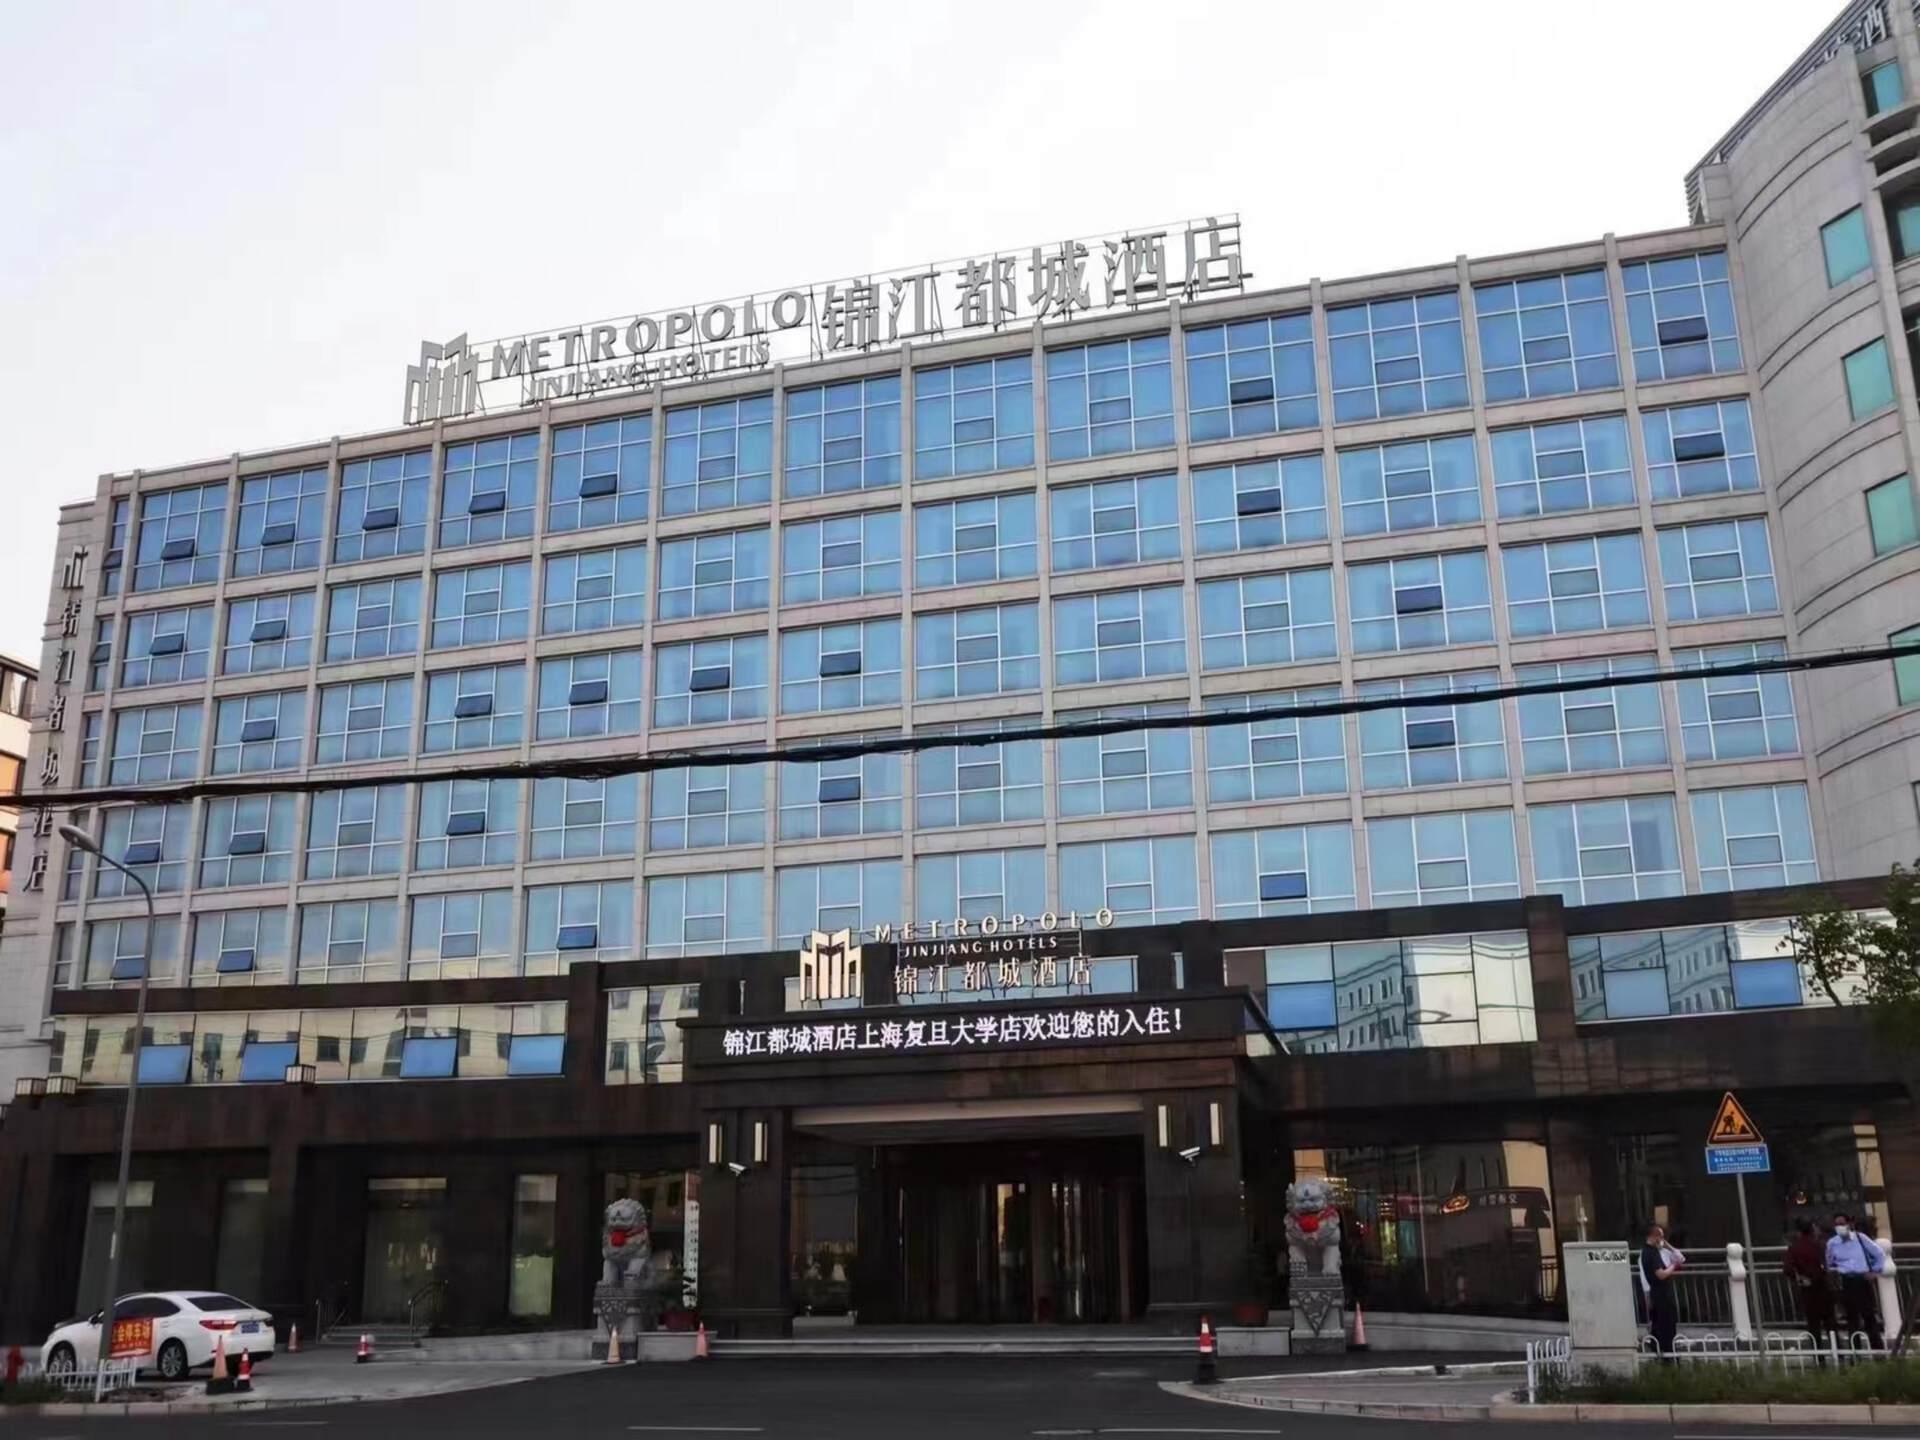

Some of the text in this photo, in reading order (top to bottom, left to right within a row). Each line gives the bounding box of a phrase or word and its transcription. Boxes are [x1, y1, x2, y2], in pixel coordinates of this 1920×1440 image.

[822, 217, 1242, 350] 锦江都城酒店
[491, 291, 807, 381] METROPOLO
[526, 341, 769, 403] JINJIANG HOTELS
[875, 907, 1114, 943] METROPOLO
[904, 935, 1058, 958] JINJIANG HOTELS
[894, 952, 1094, 995] 锦江都城酒店
